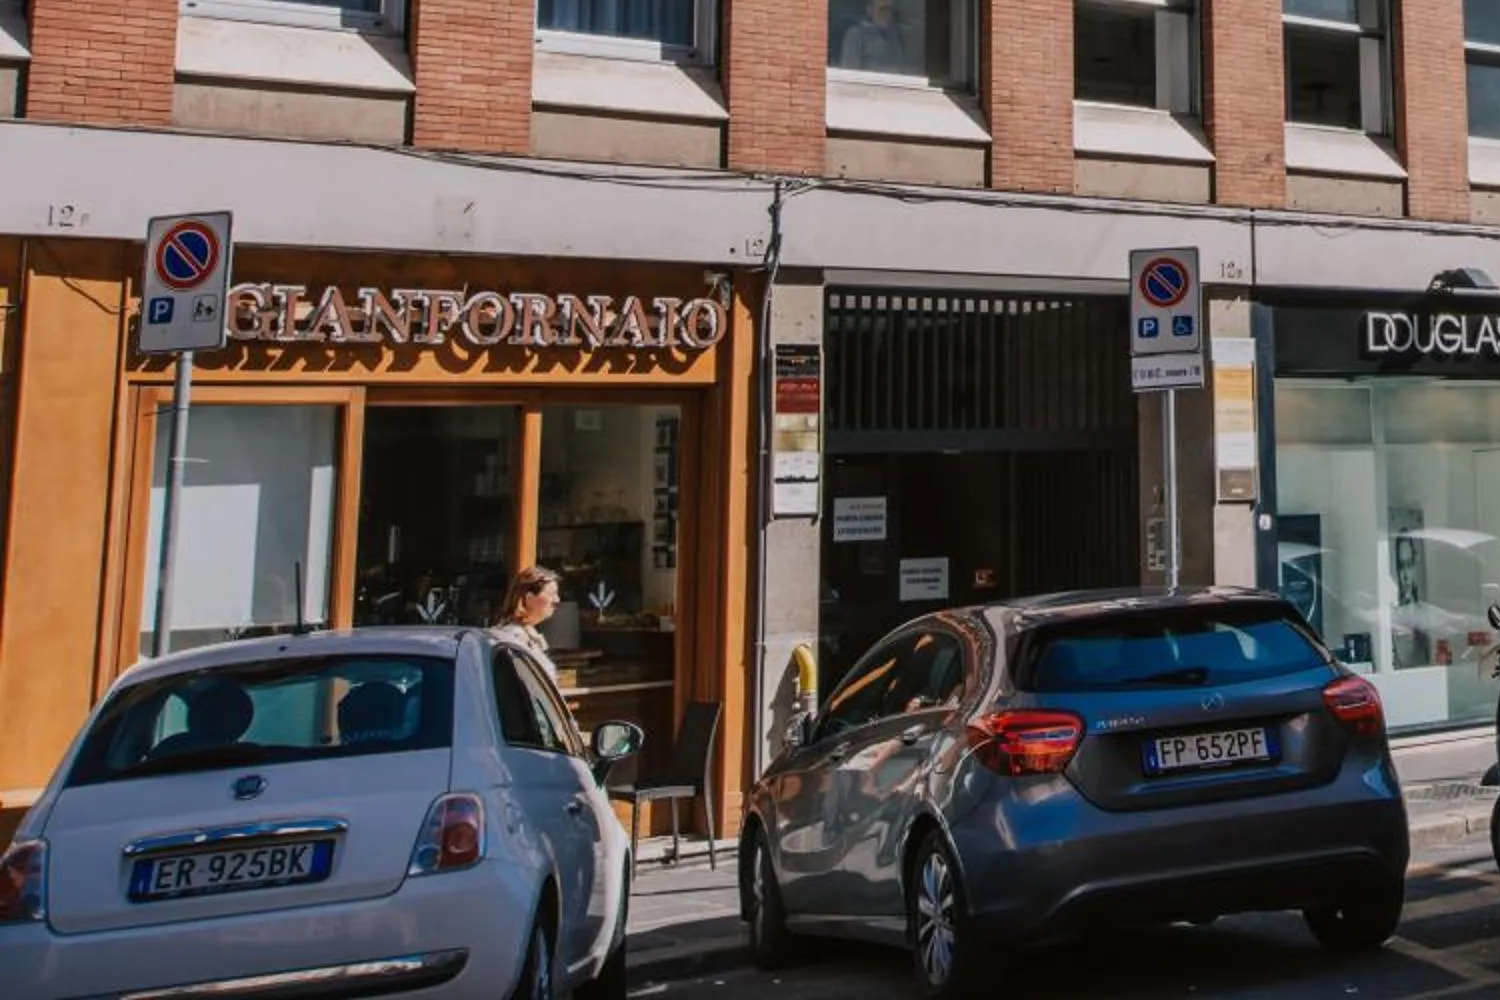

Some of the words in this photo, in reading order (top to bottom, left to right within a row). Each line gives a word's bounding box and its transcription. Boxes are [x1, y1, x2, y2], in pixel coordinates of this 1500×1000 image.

[153, 302, 168, 320] P
[227, 283, 727, 348] GIANFORNAIO
[1143, 319, 1155, 336] P
[1160, 739, 1186, 765] FP
[1196, 730, 1264, 761] 652PF
[155, 857, 196, 890] ER
[207, 845, 308, 882] 925BK
